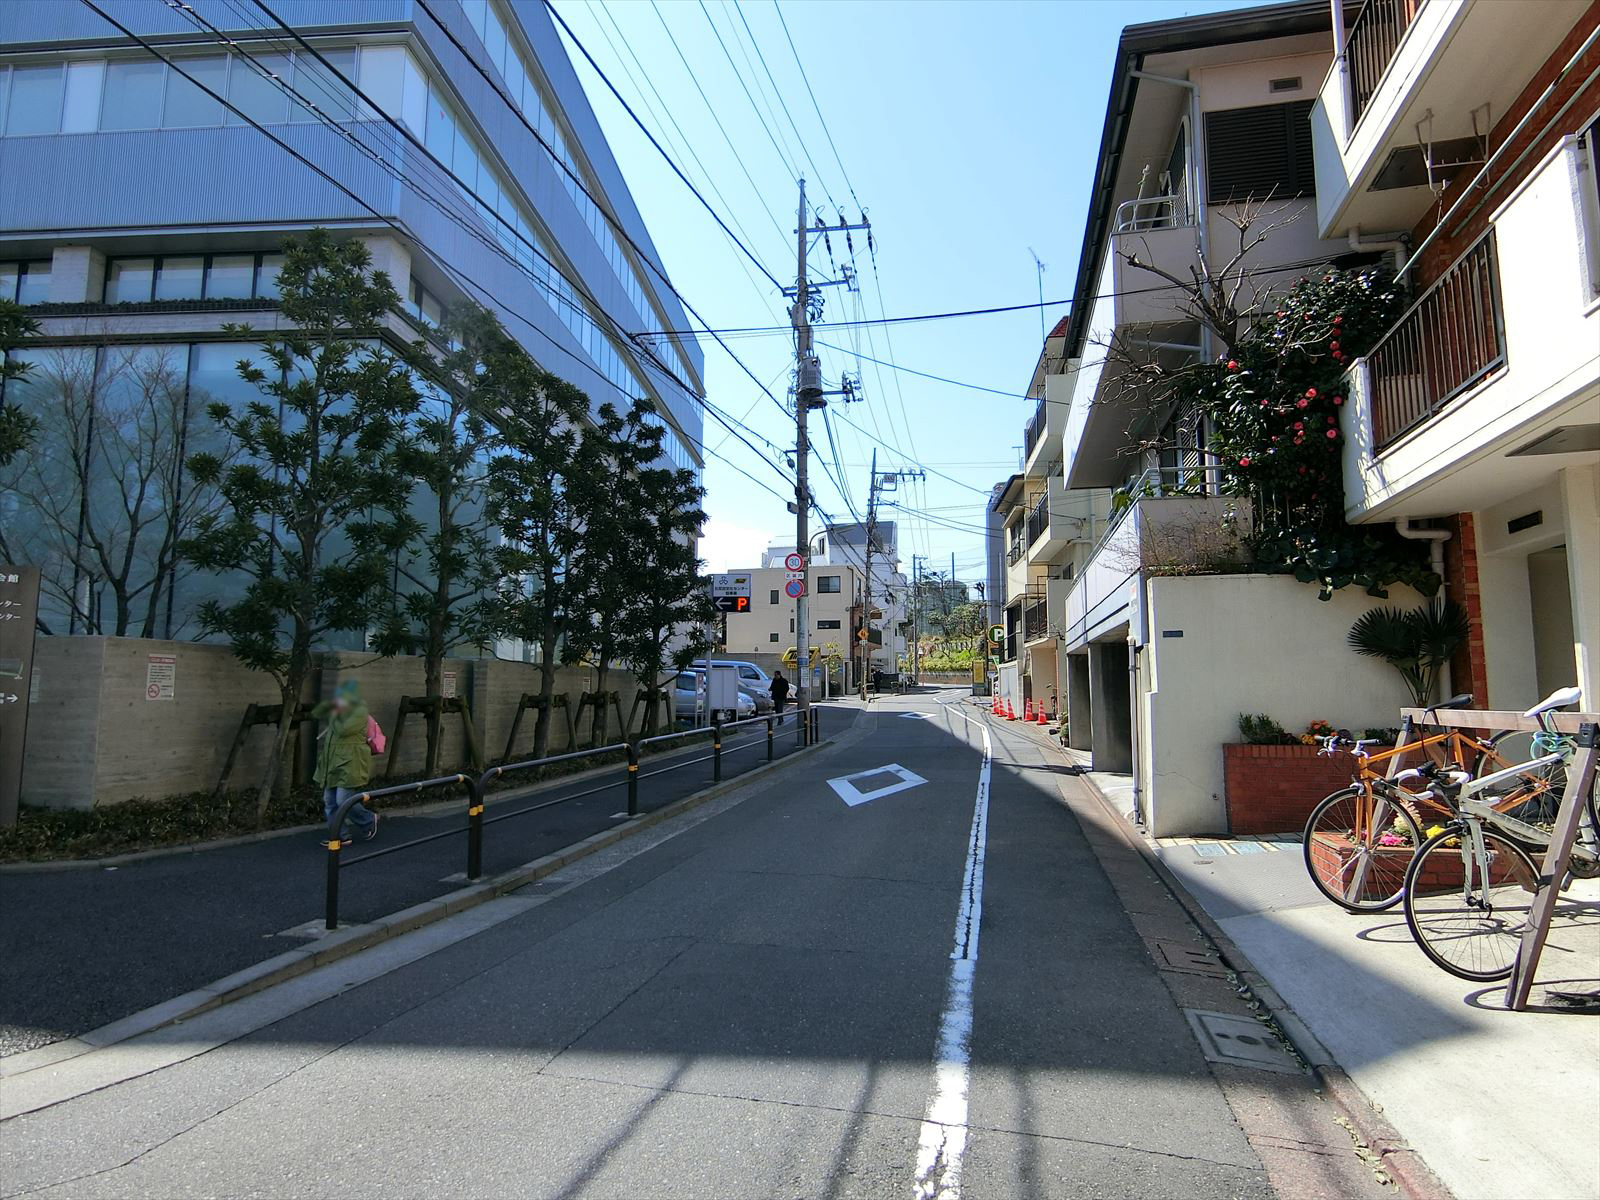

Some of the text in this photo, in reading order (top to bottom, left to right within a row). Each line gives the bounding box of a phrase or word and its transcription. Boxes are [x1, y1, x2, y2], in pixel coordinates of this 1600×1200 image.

[789, 558, 800, 567] 30
[737, 597, 748, 611] P
[994, 628, 1004, 641] P
